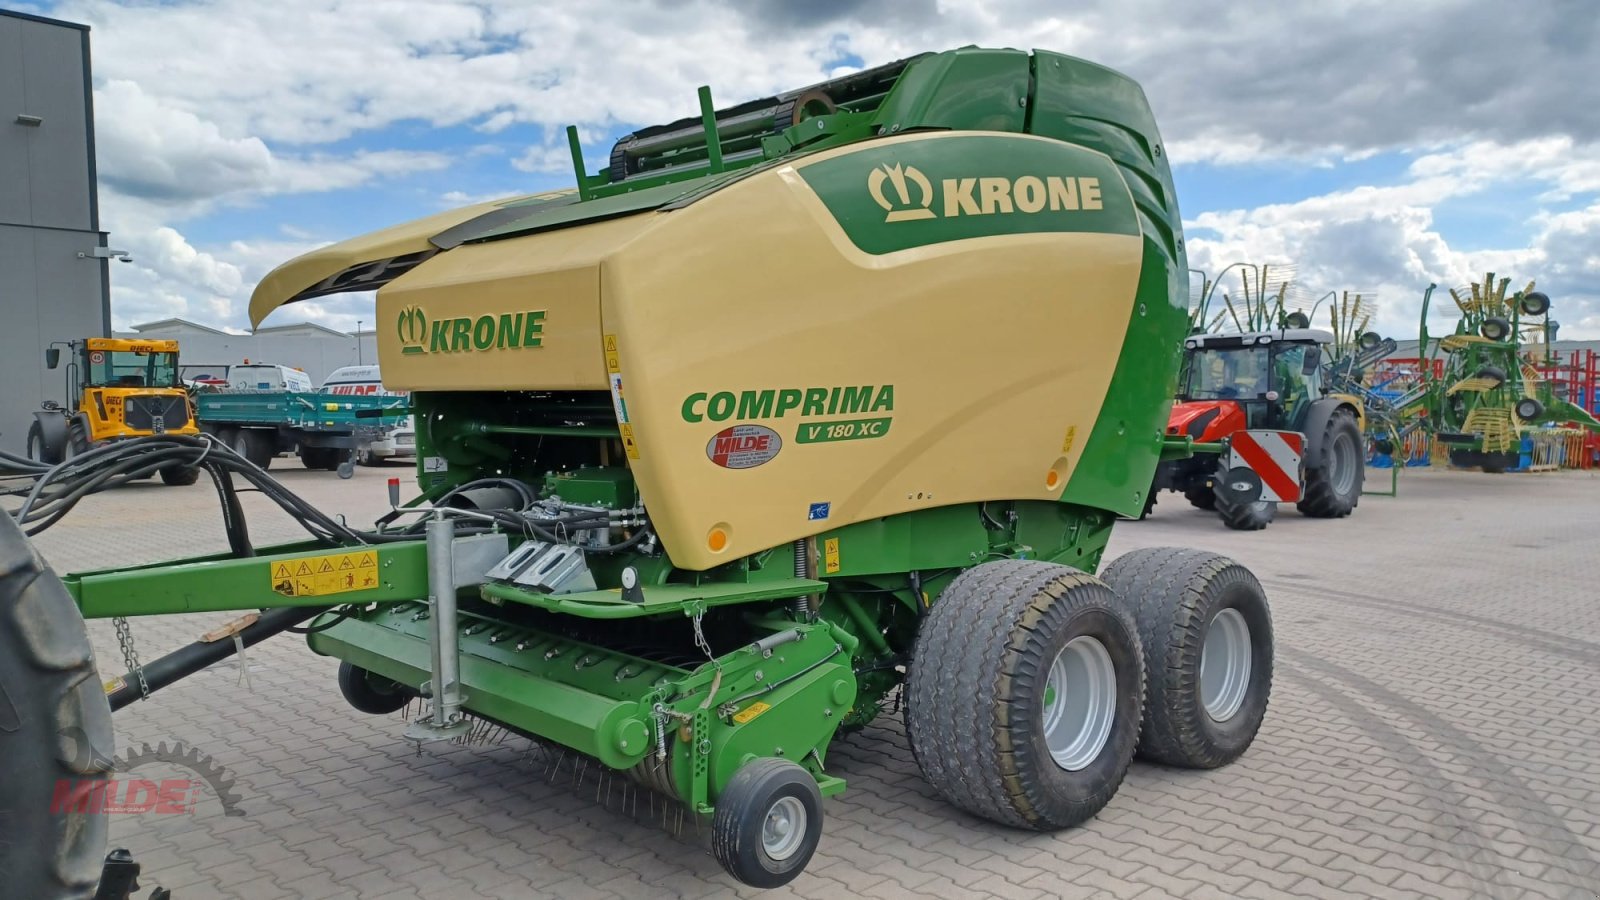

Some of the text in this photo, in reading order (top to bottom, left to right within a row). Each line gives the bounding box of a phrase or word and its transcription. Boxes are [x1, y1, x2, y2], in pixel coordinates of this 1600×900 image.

[942, 175, 1104, 218] KRONE
[430, 310, 547, 353] KRONE
[681, 384, 894, 423] COMPRIMA
[713, 435, 770, 454] MILDE
[808, 421, 882, 440] V 180 XC
